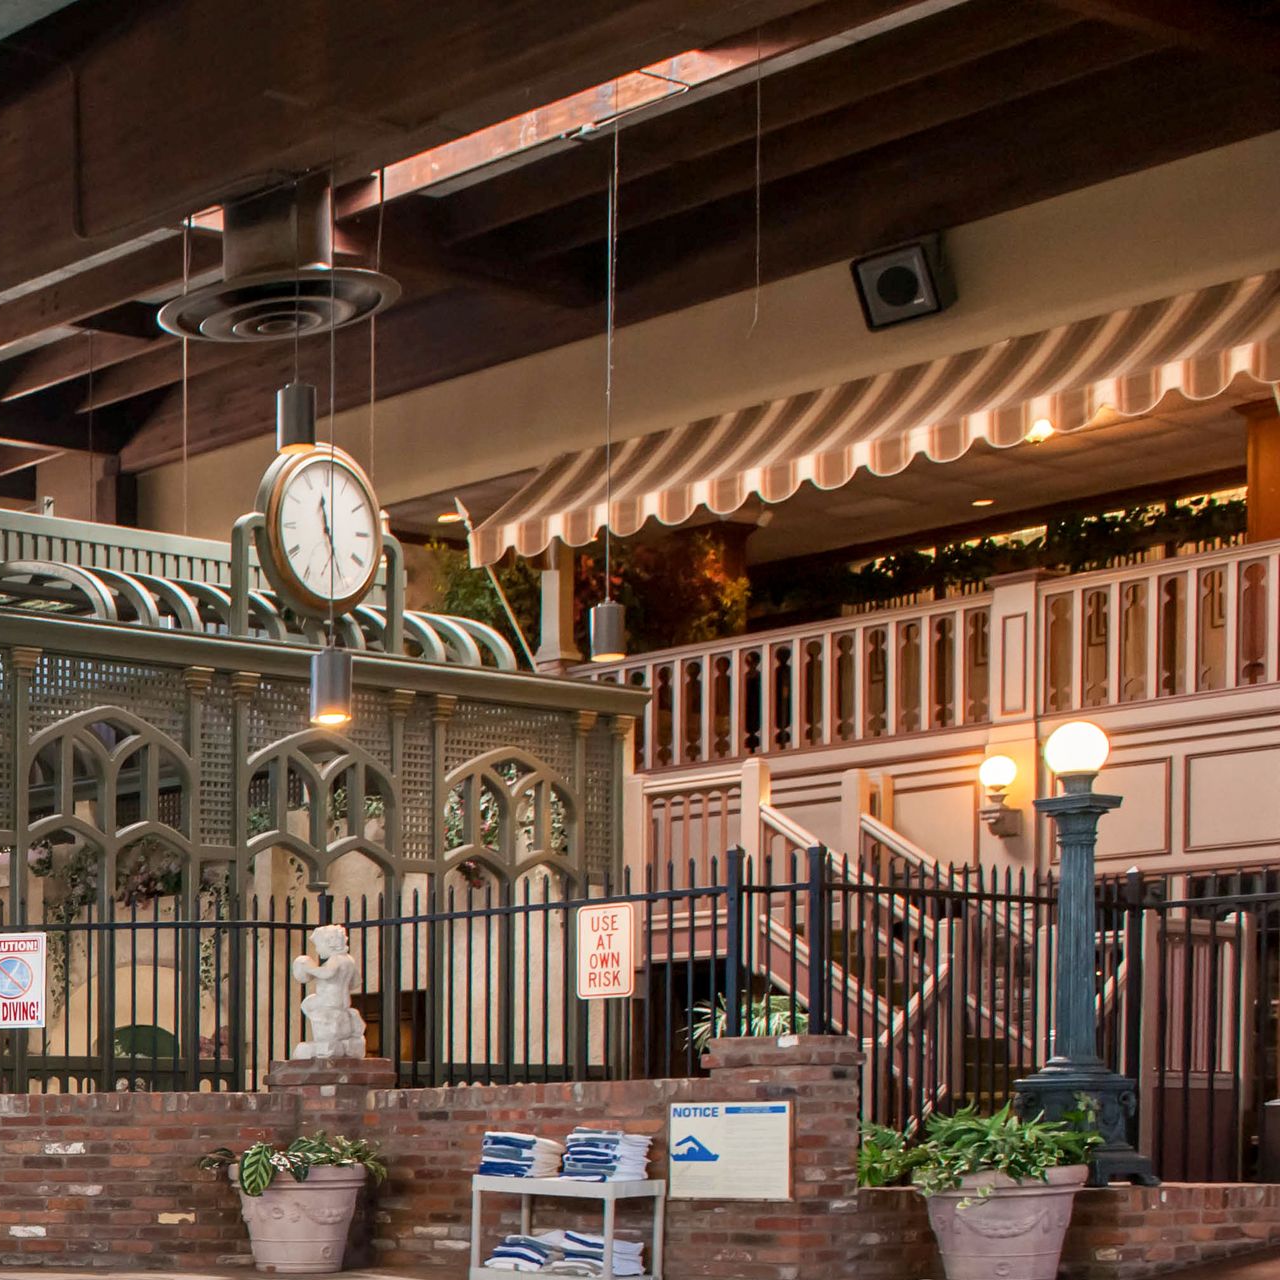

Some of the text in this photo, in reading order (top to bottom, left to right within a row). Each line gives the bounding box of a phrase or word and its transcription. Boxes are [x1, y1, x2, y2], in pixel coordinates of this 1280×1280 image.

[591, 914, 618, 932] USE
[596, 934, 613, 950] AT
[589, 952, 620, 969] OWN
[588, 970, 621, 988] RISK
[2, 1001, 39, 1021] DIVING!
[672, 1106, 719, 1117] NOTICE
